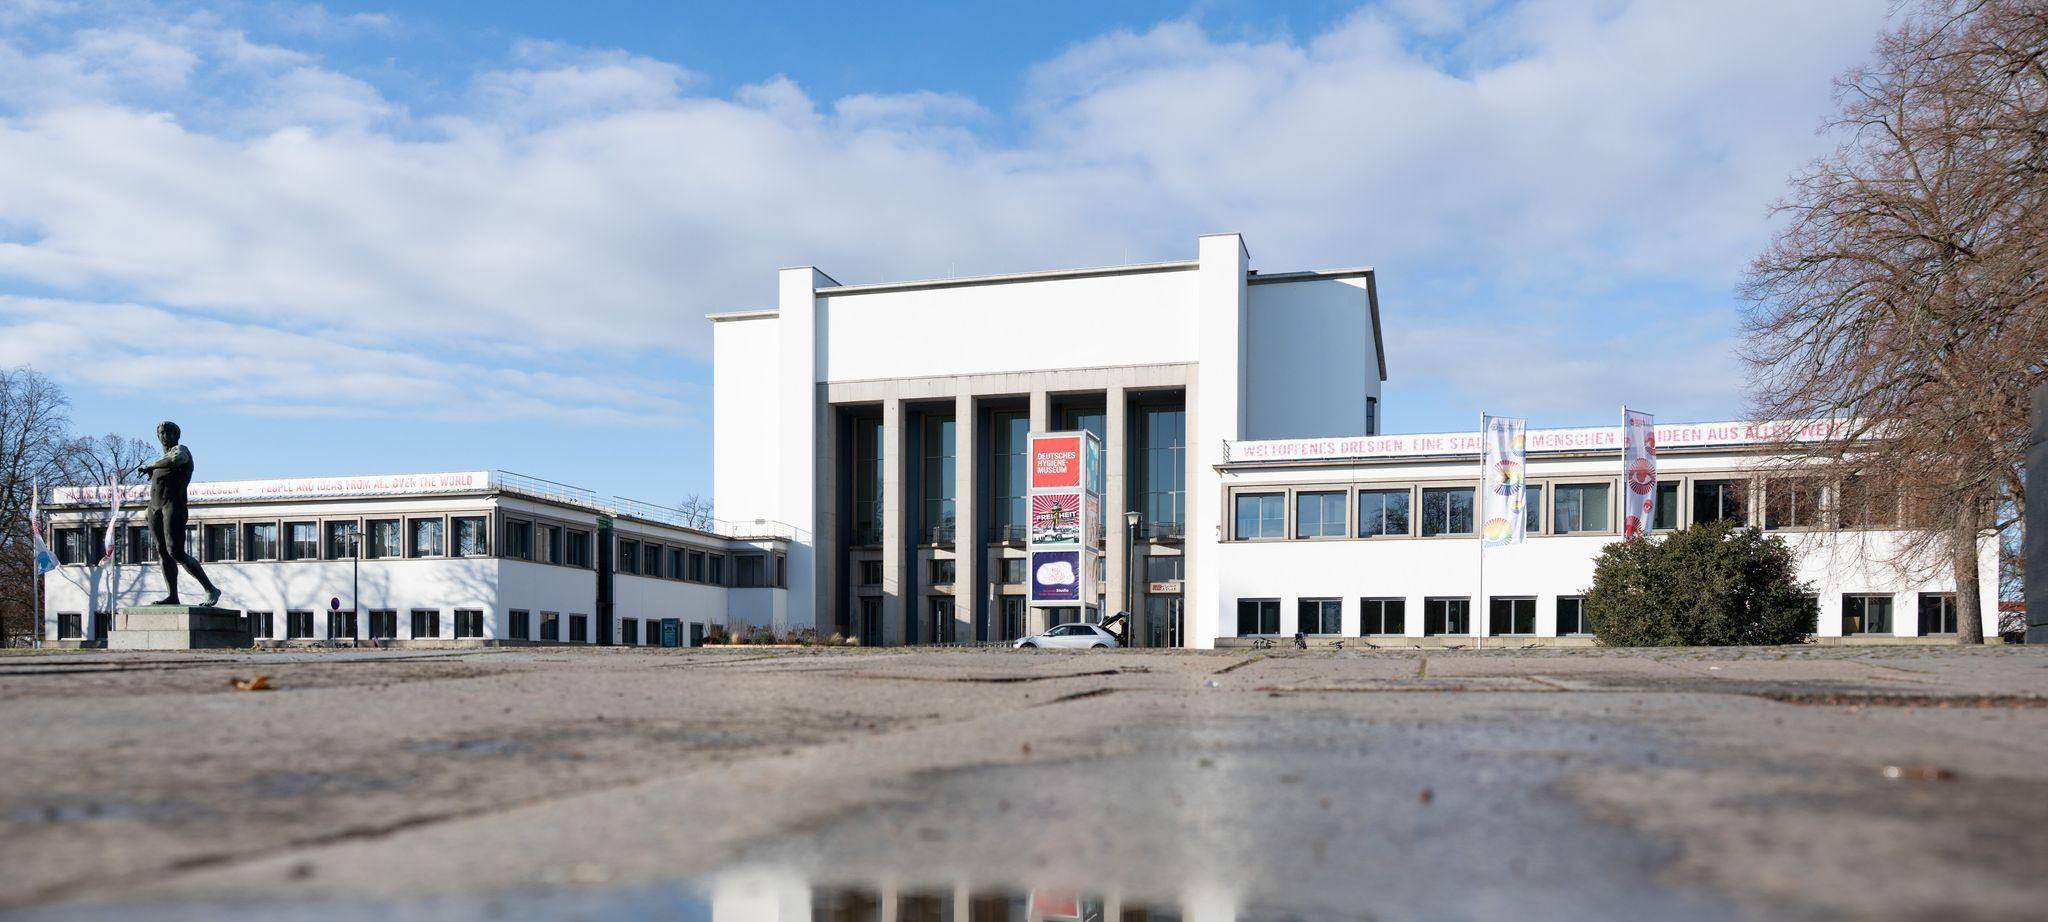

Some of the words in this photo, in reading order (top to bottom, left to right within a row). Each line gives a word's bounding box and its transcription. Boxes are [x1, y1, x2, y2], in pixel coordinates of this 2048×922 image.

[1413, 437, 1444, 451] EINE
[1532, 432, 1614, 448] MENSCHEN
[1657, 429, 1701, 443] IDEEN
[1707, 426, 1739, 441] AUS
[1037, 452, 1076, 460] DEUTSCHES
[1037, 459, 1068, 467] HYGIENE-
[1037, 466, 1067, 474] MUSEUM
[261, 483, 293, 493] PEOPLE
[295, 482, 312, 492] AND
[316, 480, 342, 491] IDEAS
[346, 479, 370, 490] FROM
[374, 479, 390, 489] ALL
[392, 477, 416, 488] OVER
[420, 477, 436, 487] THE
[440, 475, 473, 487] WORLD
